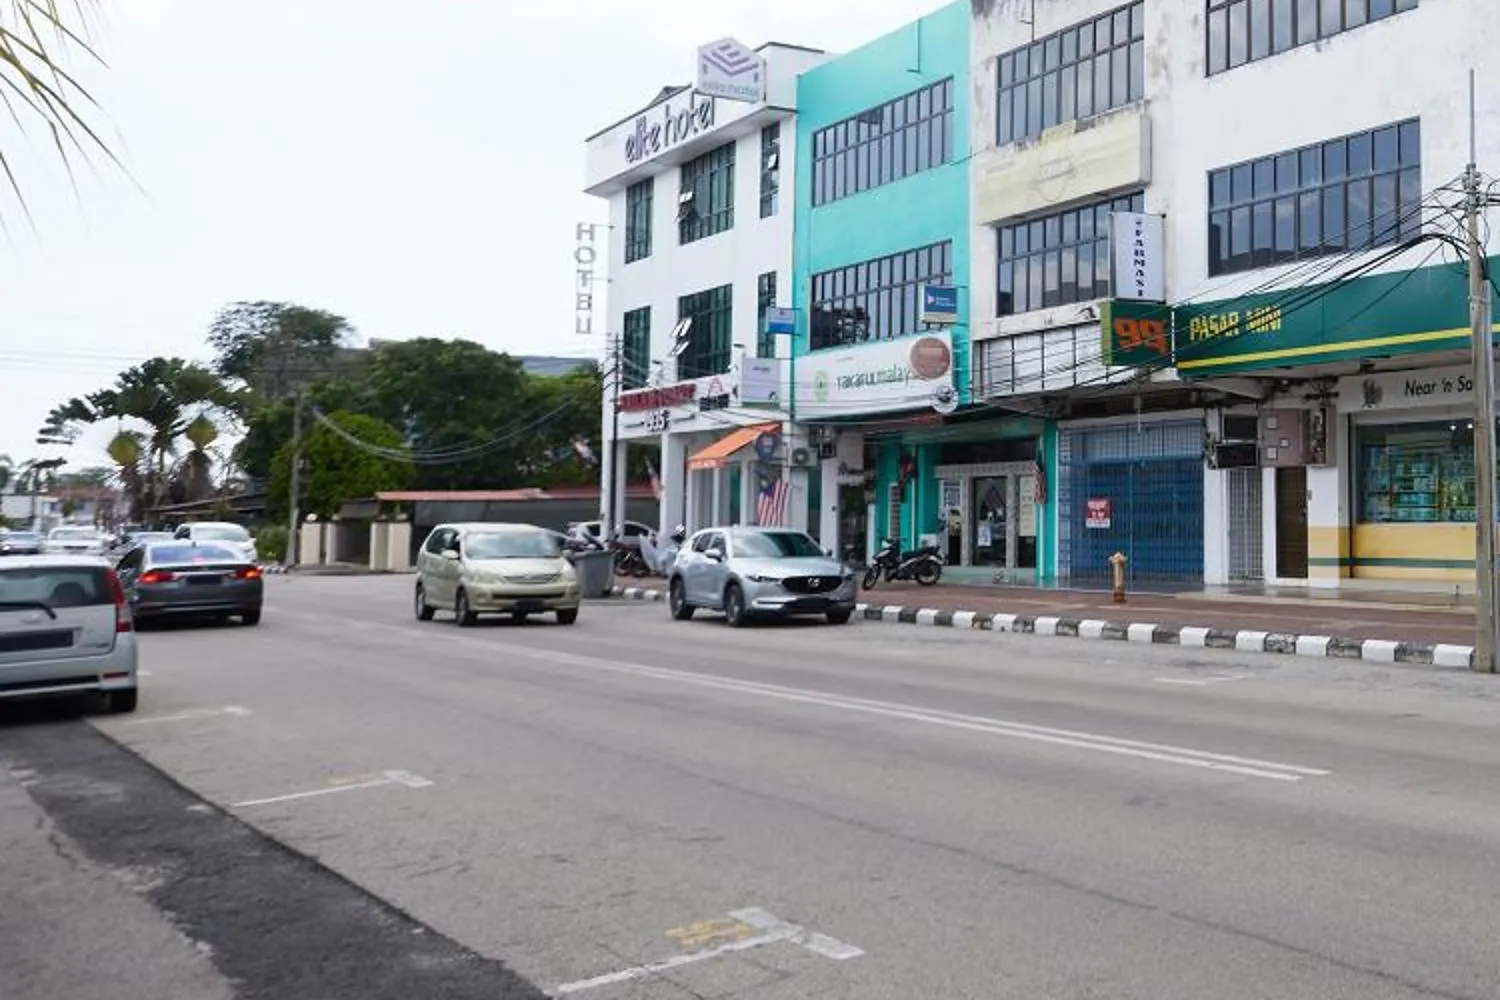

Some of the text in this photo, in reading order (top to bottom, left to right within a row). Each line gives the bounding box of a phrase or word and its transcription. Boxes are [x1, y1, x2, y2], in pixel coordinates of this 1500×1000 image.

[625, 99, 715, 163] elite hotel
[1114, 316, 1169, 356] 99
[1189, 311, 1240, 341] PASAR
[1405, 378, 1437, 396] Near
